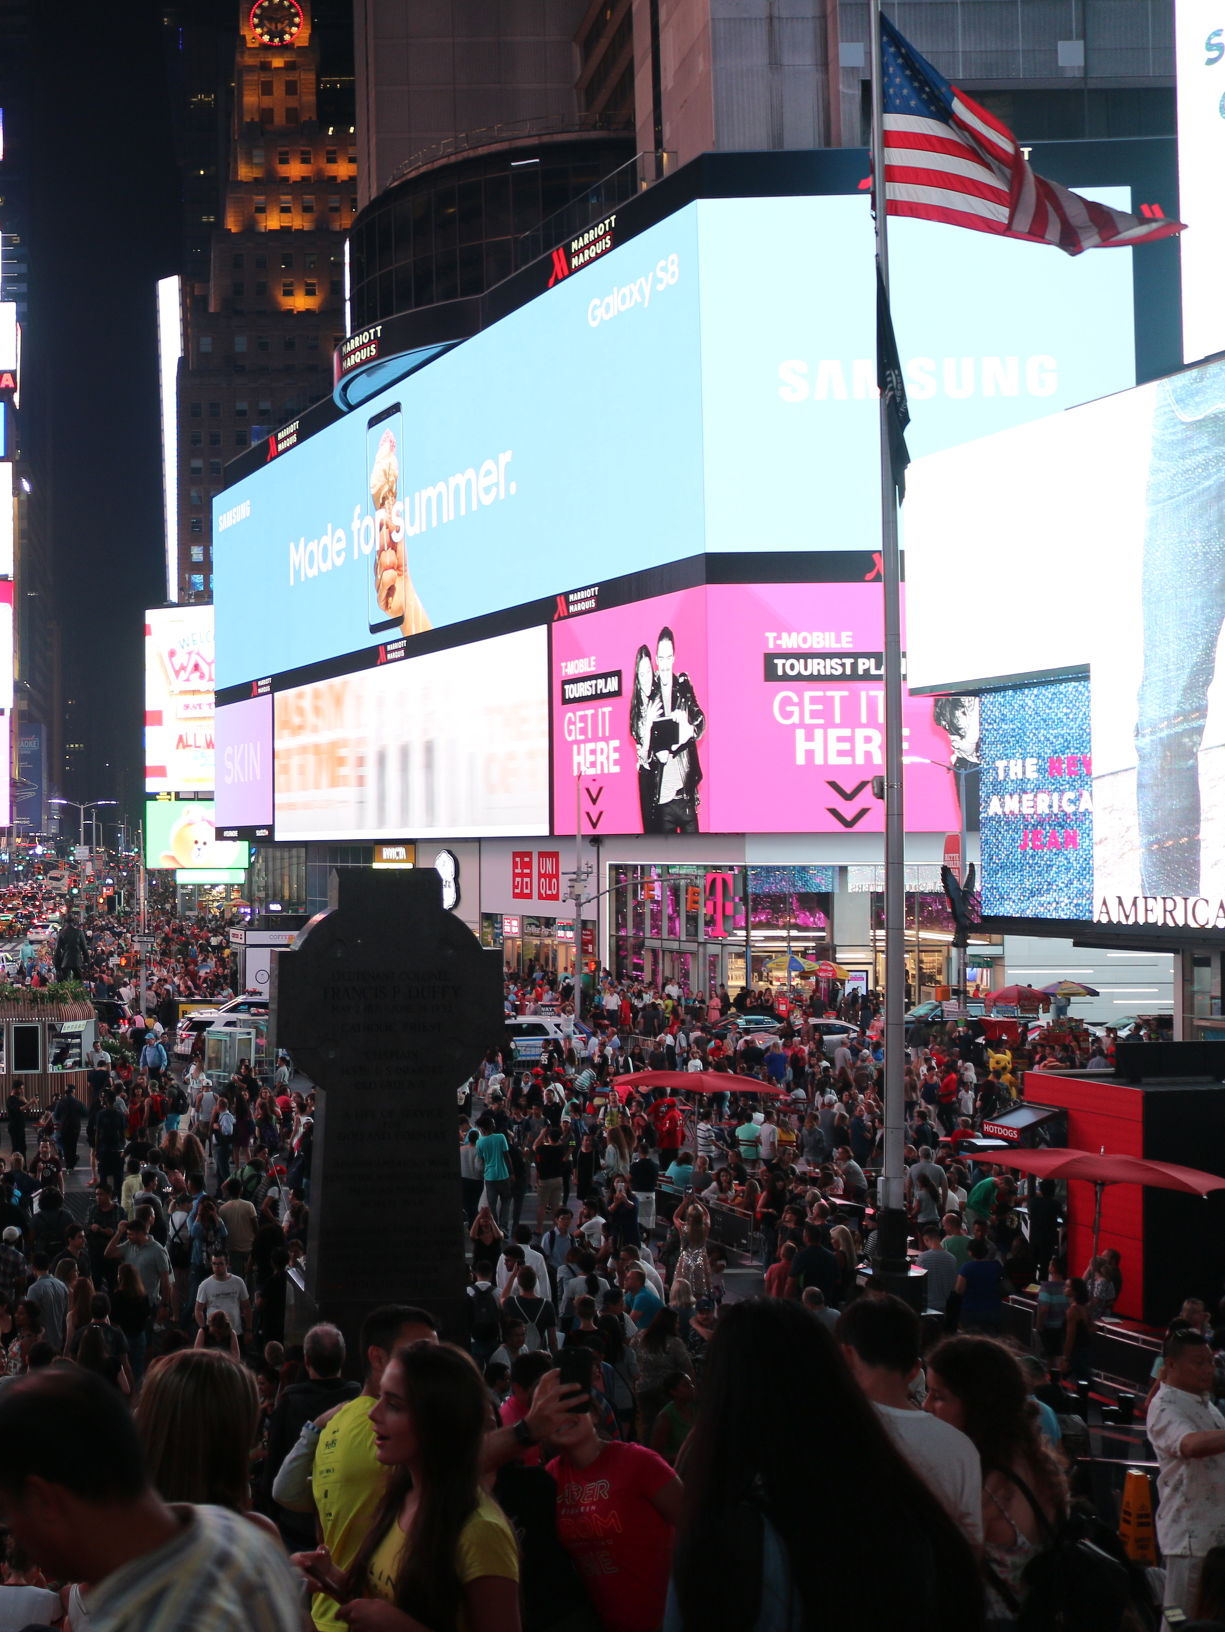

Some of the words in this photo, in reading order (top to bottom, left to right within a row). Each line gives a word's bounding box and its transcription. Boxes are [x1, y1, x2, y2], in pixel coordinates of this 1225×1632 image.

[570, 214, 617, 253] MARRIOTT
[570, 234, 613, 270] MARQUIS
[586, 269, 653, 329] Galaxy
[655, 253, 680, 293] S8
[341, 325, 383, 355] MARRIOTT
[341, 342, 378, 372] MARQUIS
[778, 353, 1059, 403] SAMSUNG
[277, 420, 300, 442] MARRIOTT
[277, 433, 298, 453] MARQUIS
[218, 499, 252, 533] SAMSUNG
[289, 523, 346, 587] Made
[351, 503, 389, 561] for
[390, 449, 518, 543] summer.
[569, 586, 600, 603] MARRIOTT
[569, 598, 596, 614] MARQUIS
[764, 631, 854, 650] T-MOBILE
[560, 655, 597, 677] T-MOBILE
[773, 657, 853, 677] TOURIST
[564, 680, 597, 700] TOURIST
[597, 676, 619, 696] PLAN
[772, 690, 854, 726] GET
[563, 710, 590, 742] GET
[593, 706, 613, 737] IT
[224, 740, 262, 785] SKIN
[571, 739, 621, 778] HERE
[995, 758, 1039, 780] THE
[1018, 829, 1079, 851] JEAN
[539, 856, 557, 874] UNI
[539, 877, 557, 896] QLO
[983, 1123, 1018, 1139] HOTDOGS
